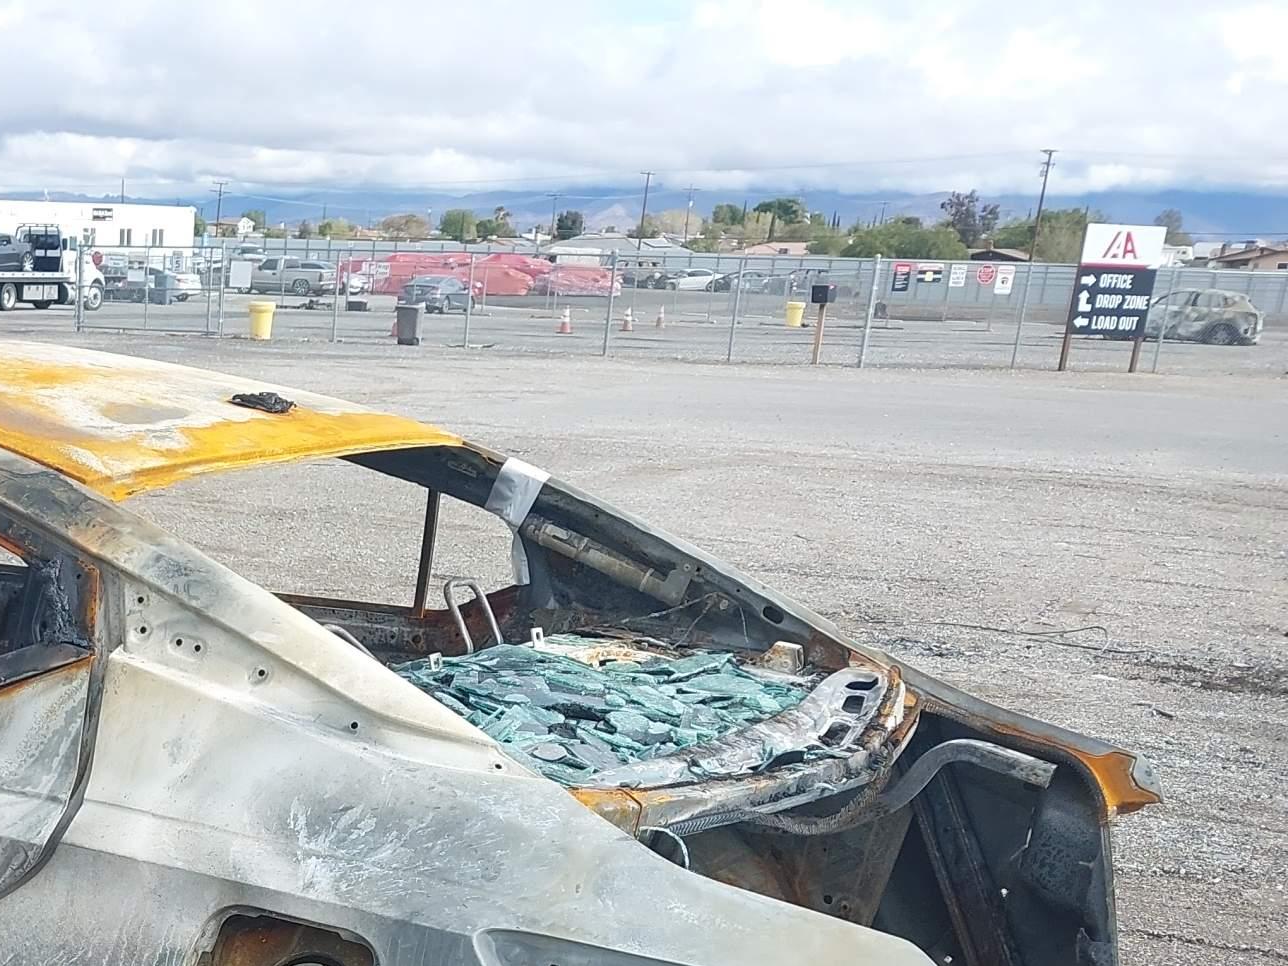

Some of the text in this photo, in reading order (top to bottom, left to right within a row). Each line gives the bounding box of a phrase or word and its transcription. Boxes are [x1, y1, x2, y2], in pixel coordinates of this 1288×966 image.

[1099, 274, 1134, 288] OFFICE
[1095, 294, 1150, 310] DROP ZONE
[1091, 315, 1139, 331] LOAD OUT
